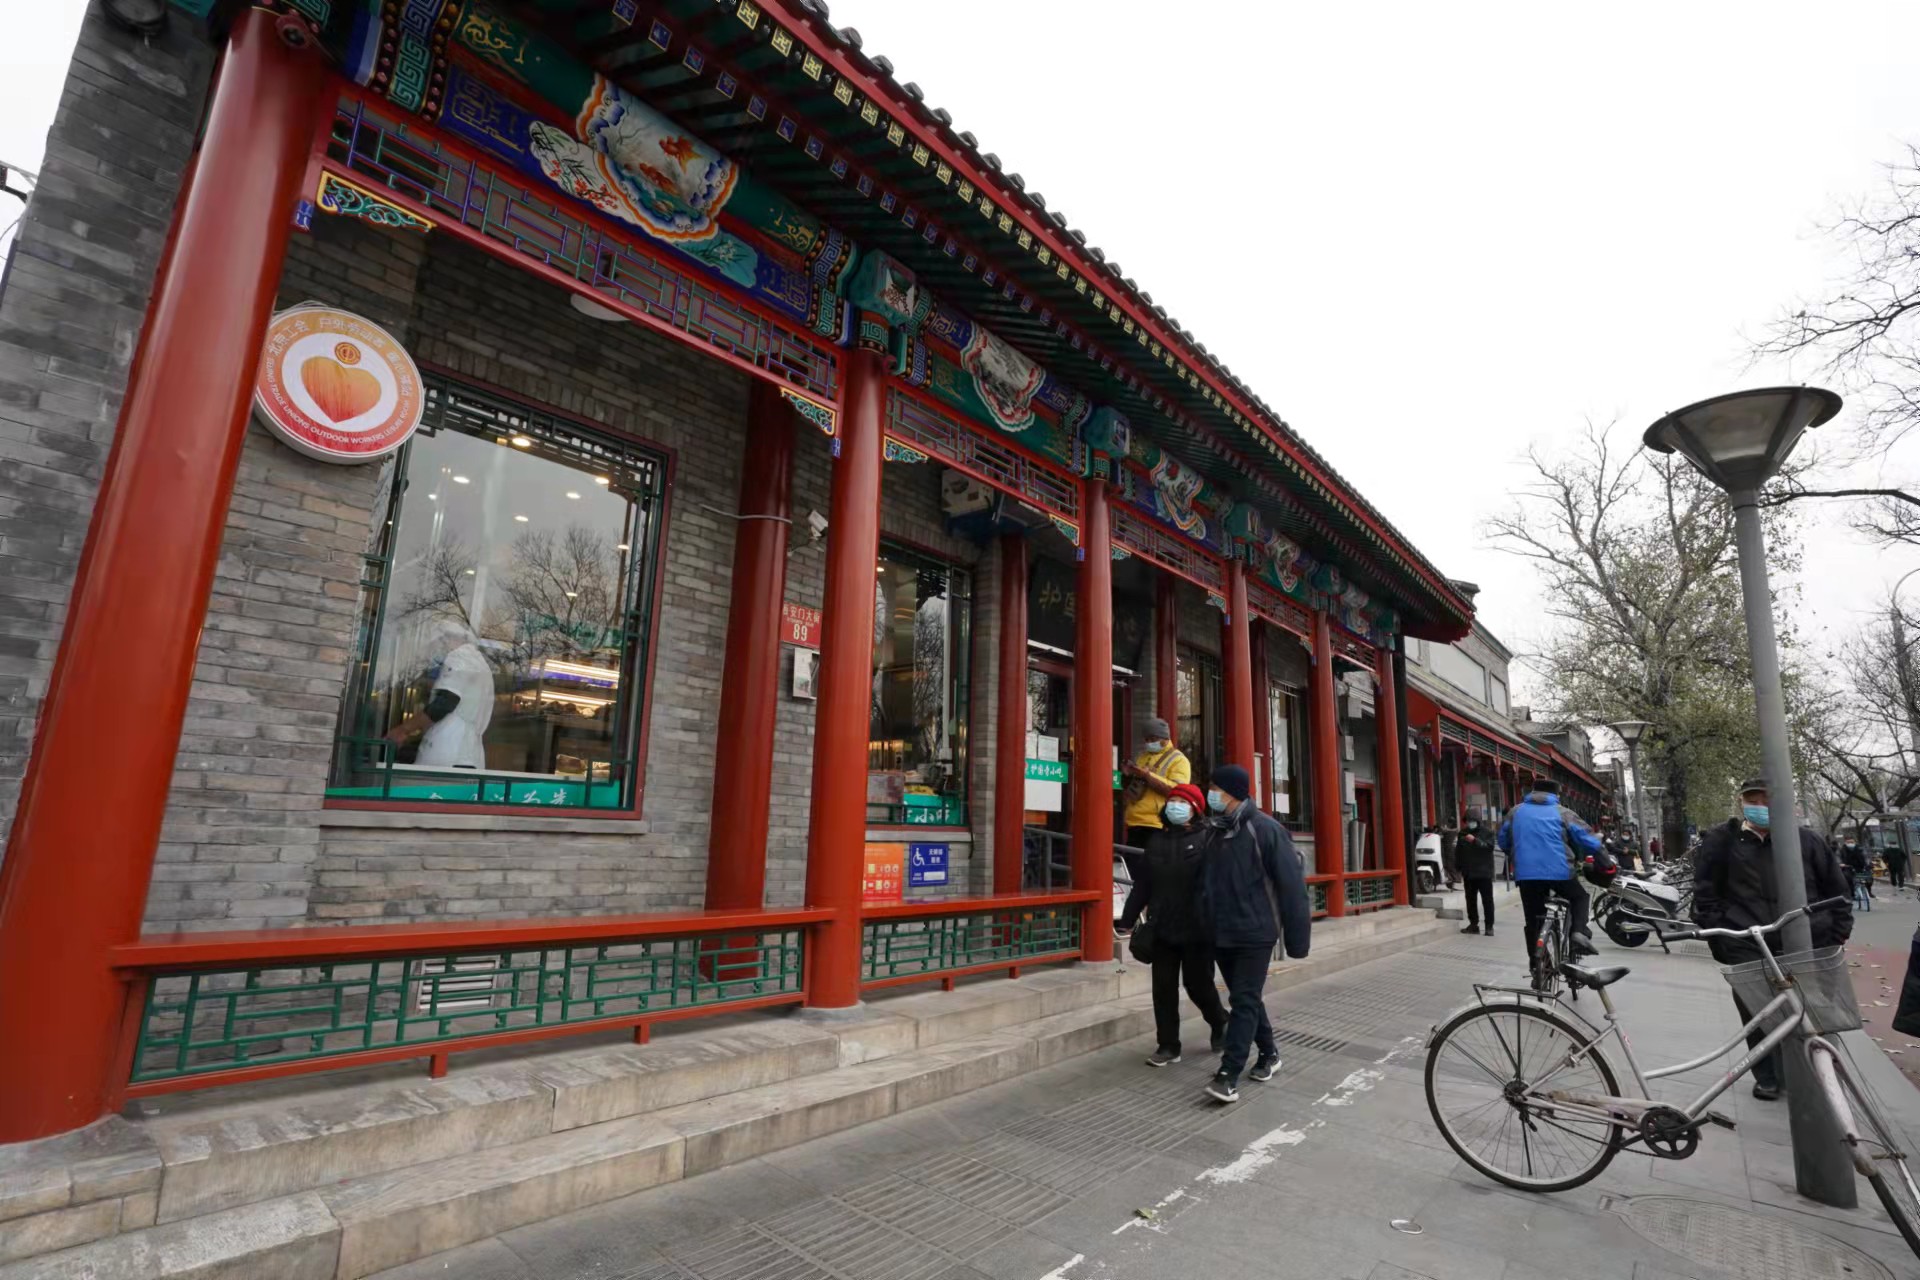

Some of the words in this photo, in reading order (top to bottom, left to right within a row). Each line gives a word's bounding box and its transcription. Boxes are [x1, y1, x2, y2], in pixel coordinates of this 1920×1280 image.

[269, 319, 309, 357] 北京工会
[270, 383, 286, 406] TRADE
[310, 425, 350, 444] OUTDOOR
[350, 432, 385, 446] WORKERS
[793, 623, 808, 642] 89
